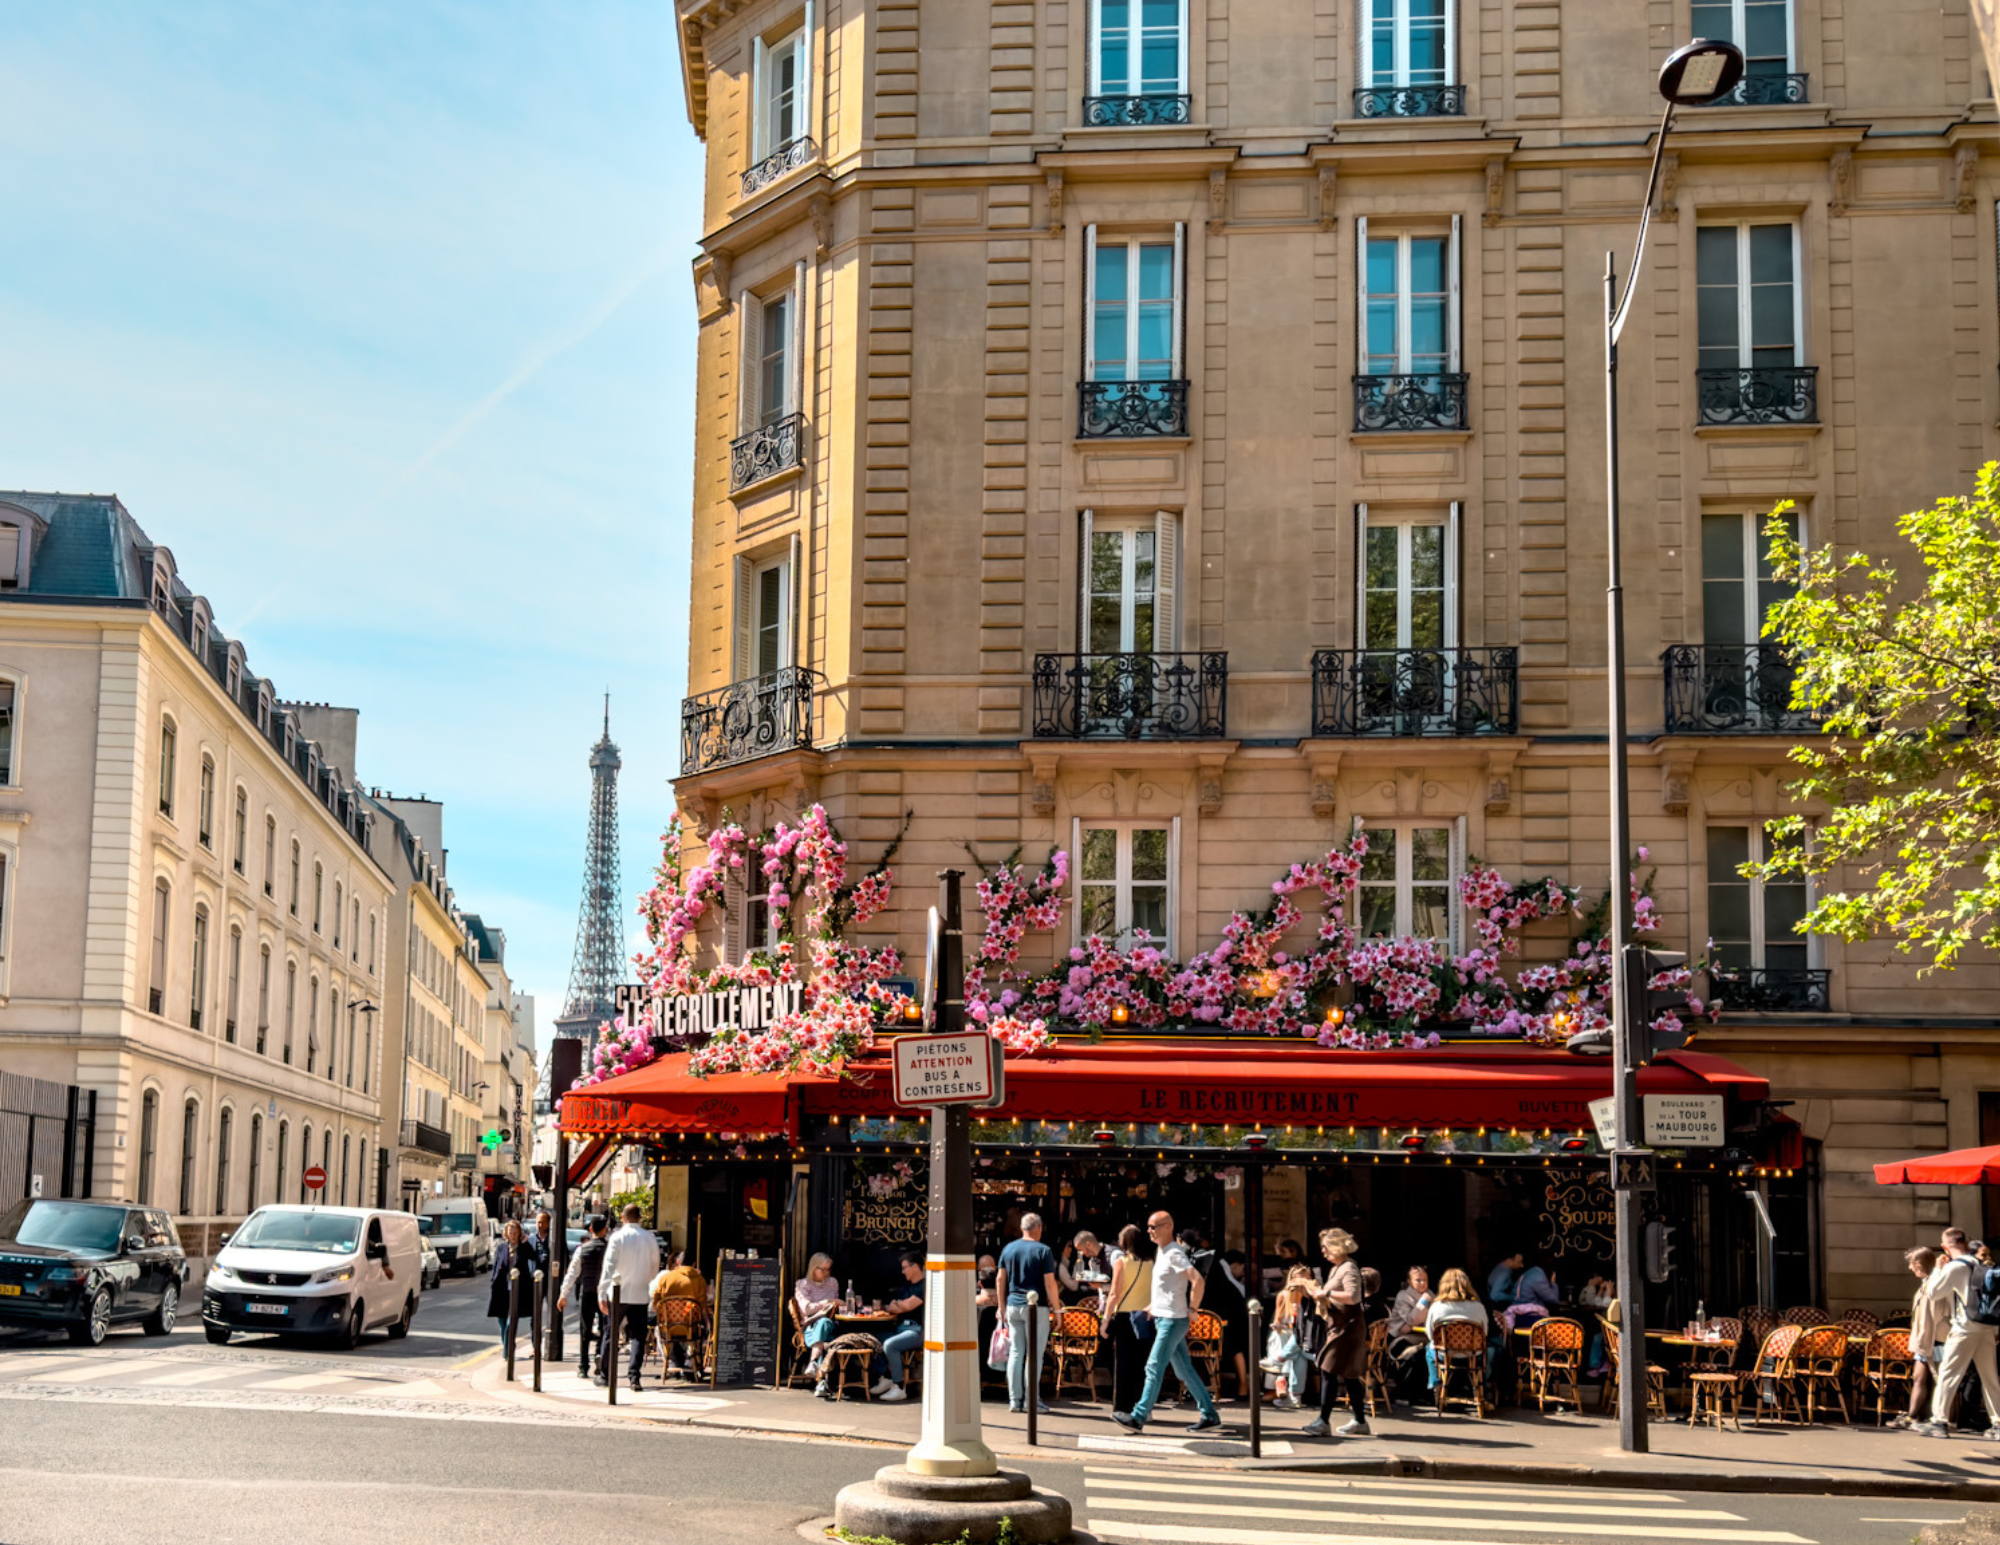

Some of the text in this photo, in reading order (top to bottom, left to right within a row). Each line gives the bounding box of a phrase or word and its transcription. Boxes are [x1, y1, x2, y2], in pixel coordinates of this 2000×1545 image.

[651, 982, 804, 1037] RECRUTEMENT
[916, 1042, 967, 1055] PIÉTONS
[910, 1056, 973, 1069] ATTENTION
[924, 1070, 961, 1082] BUS A
[905, 1082, 982, 1097] CONTRESENS
[695, 1099, 740, 1117] DEPUIS
[1139, 1089, 1359, 1113] LE RECRUTEMENT
[1679, 1110, 1707, 1119] TOUR
[855, 1212, 916, 1229] BRUNCH
